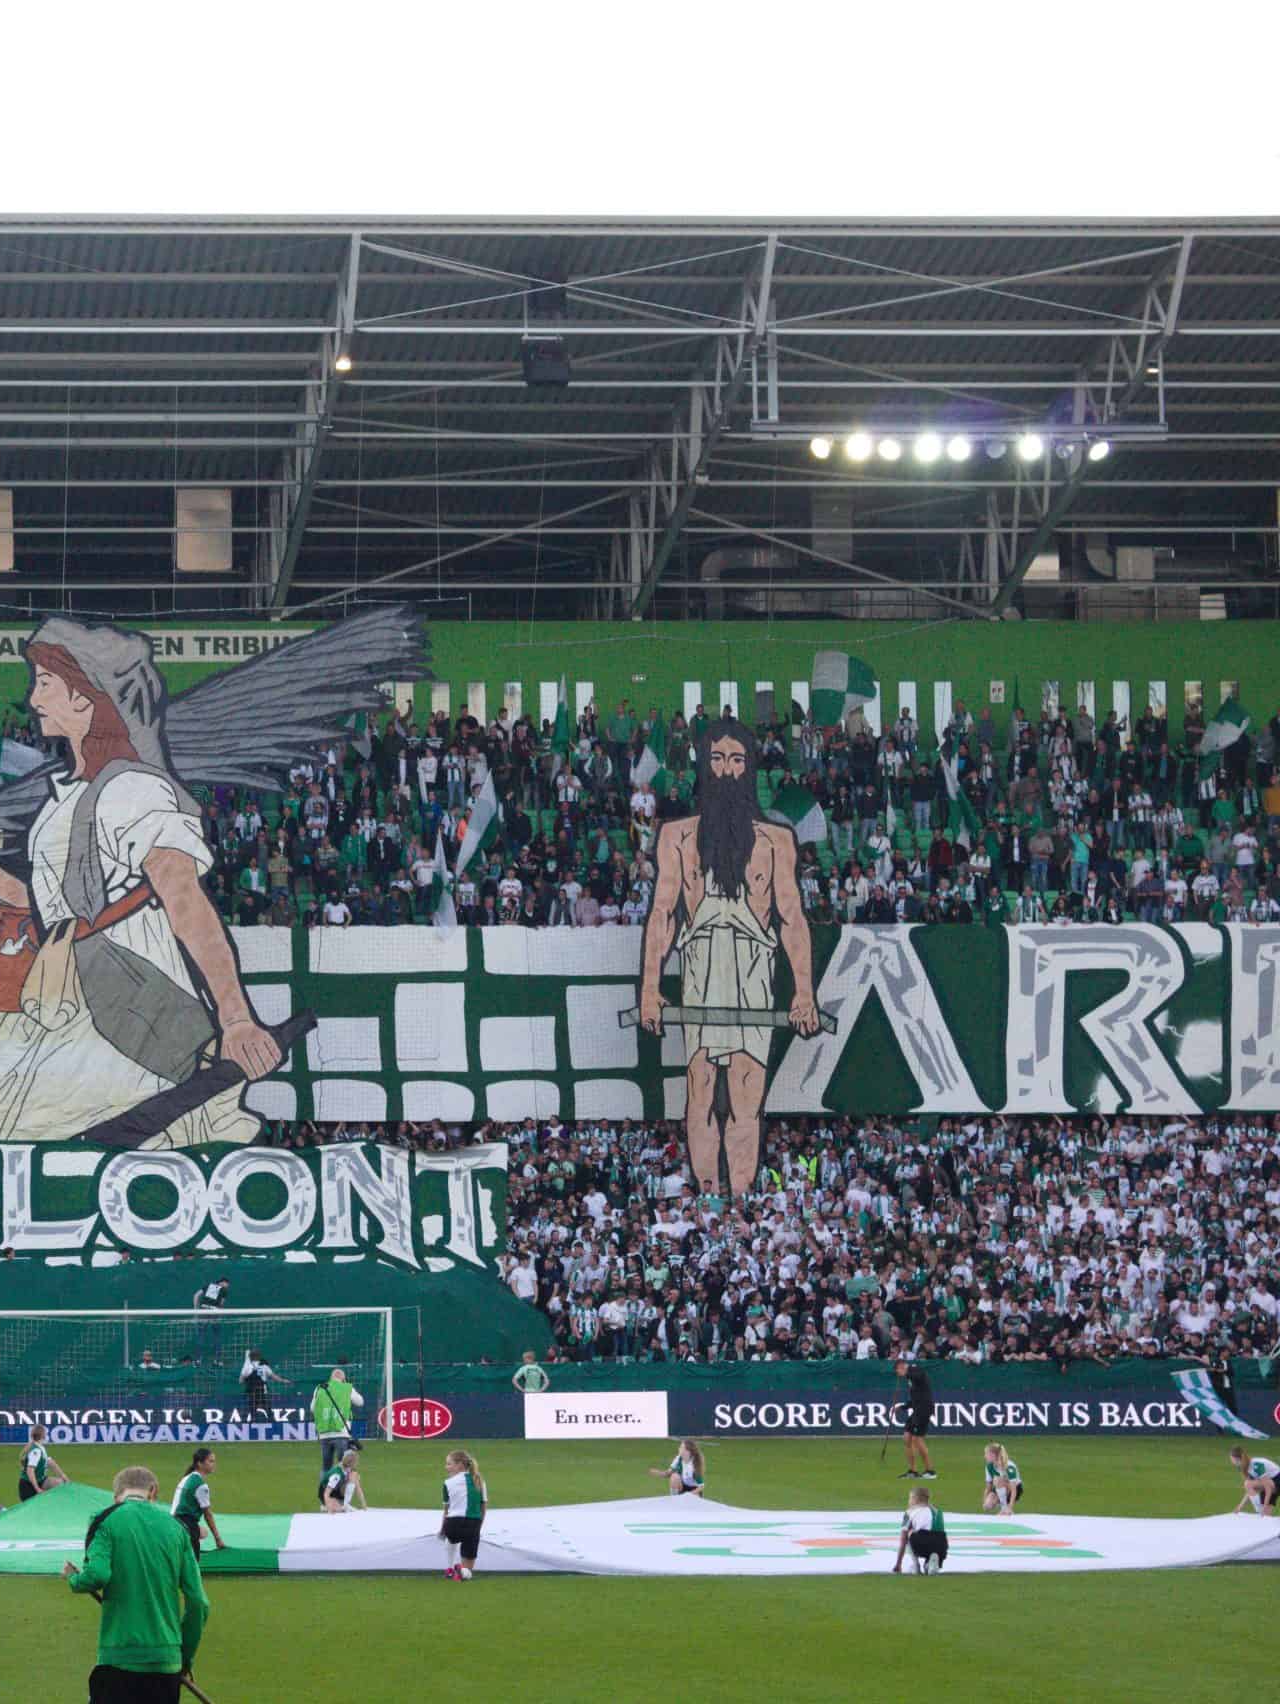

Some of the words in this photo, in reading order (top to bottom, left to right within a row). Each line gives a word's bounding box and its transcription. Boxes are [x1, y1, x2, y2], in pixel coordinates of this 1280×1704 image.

[554, 1408, 579, 1425] En
[585, 1413, 641, 1425] meer..
[714, 1402, 832, 1429] SCORE
[1058, 1402, 1091, 1428] IS
[1098, 1401, 1202, 1428] BACK!
